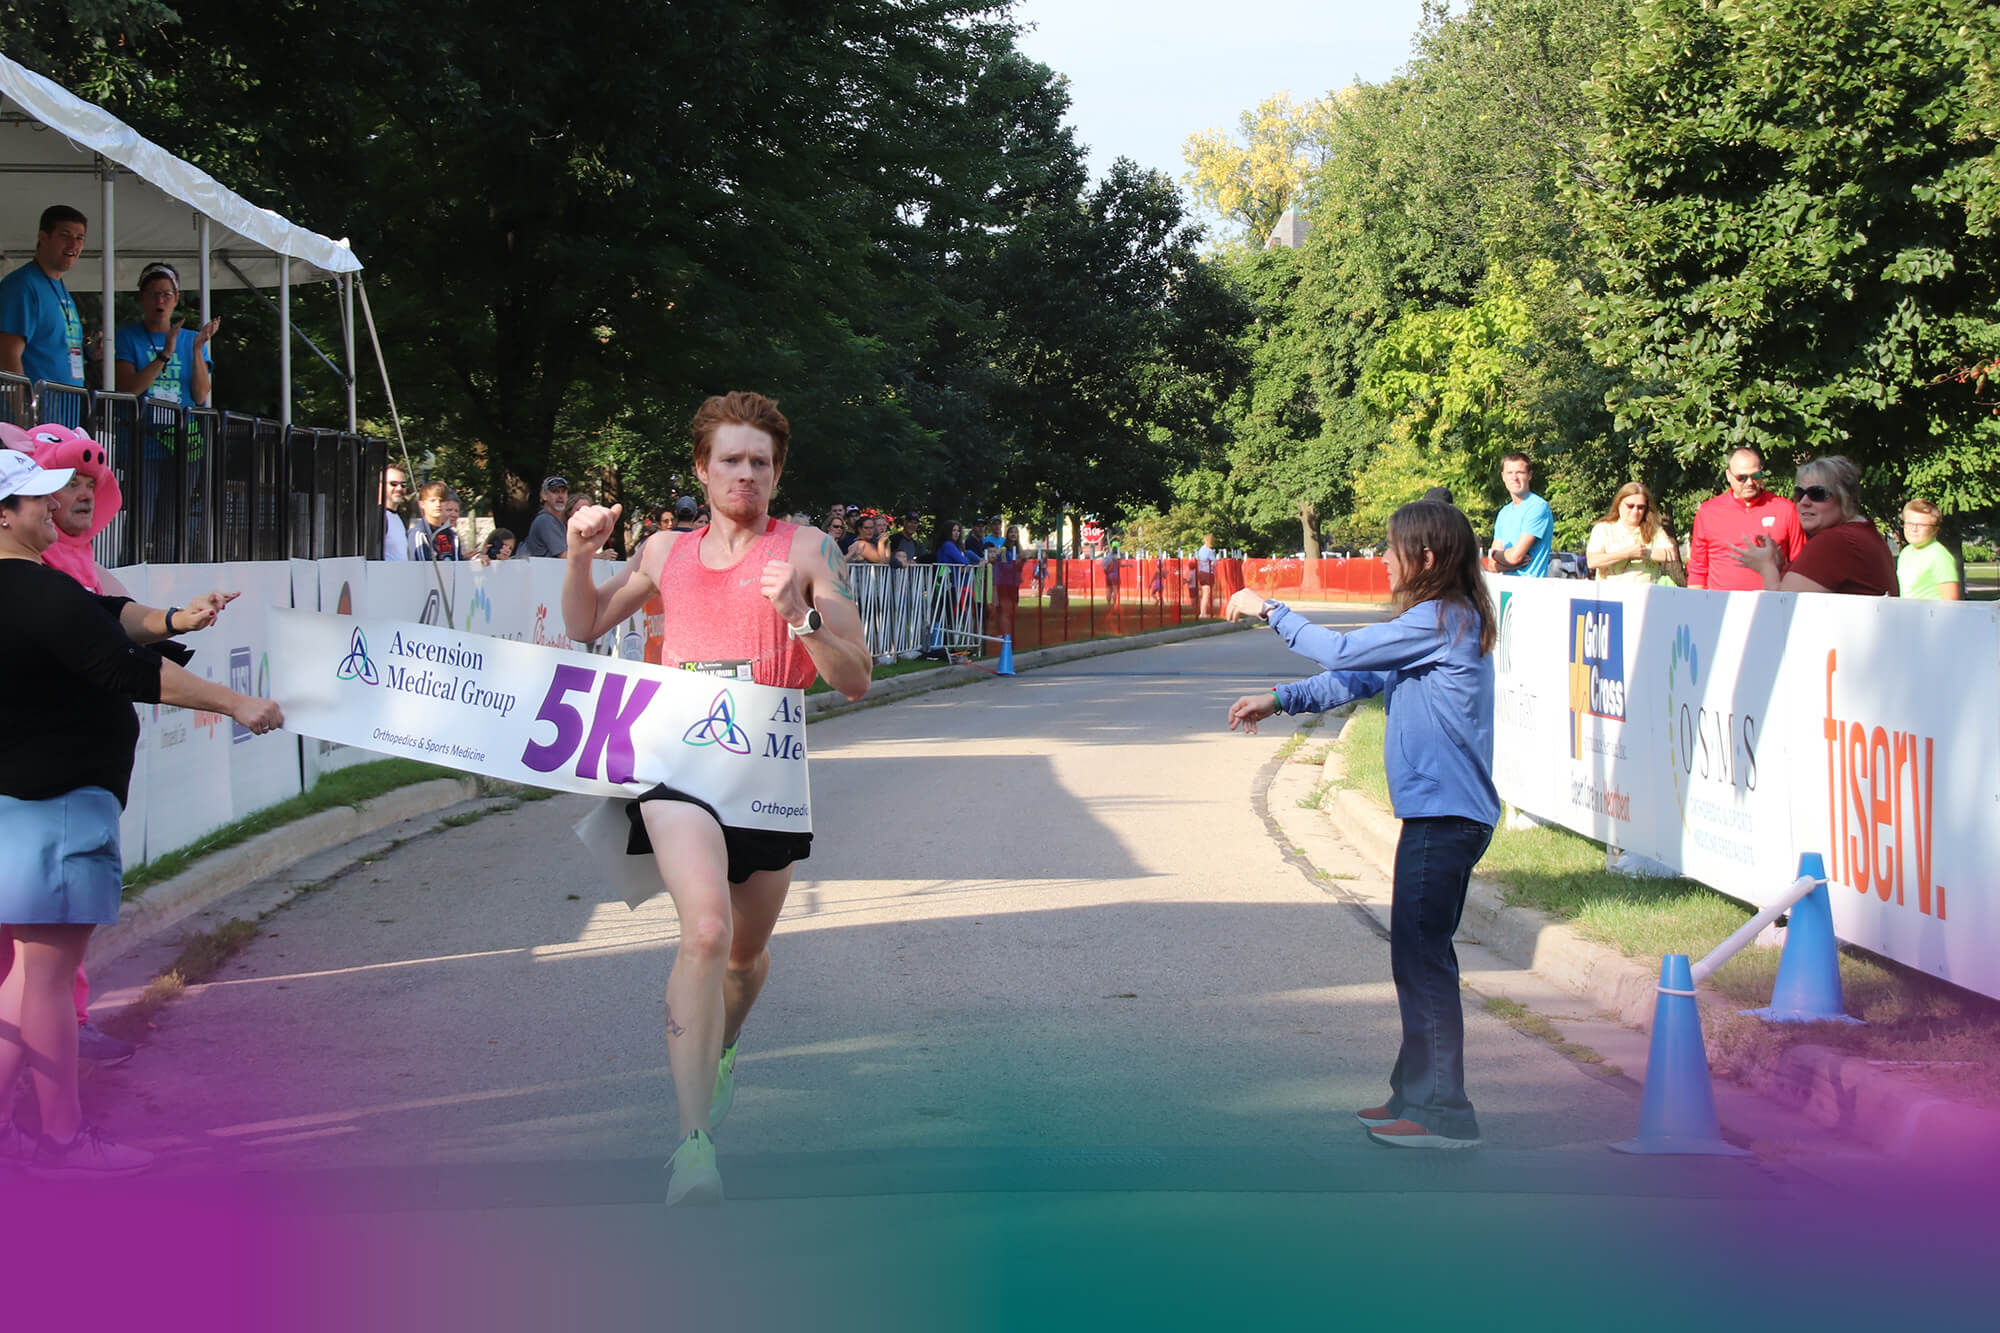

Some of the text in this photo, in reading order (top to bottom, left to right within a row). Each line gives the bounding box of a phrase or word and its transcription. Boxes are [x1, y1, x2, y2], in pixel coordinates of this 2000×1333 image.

[389, 630, 483, 671] Ascension
[1584, 610, 1609, 660] Gold
[386, 664, 516, 718] Medical Group
[1590, 664, 1625, 717] Cross
[373, 727, 486, 762] Orthopedics & Sports Medicine
[521, 664, 662, 785] 5K
